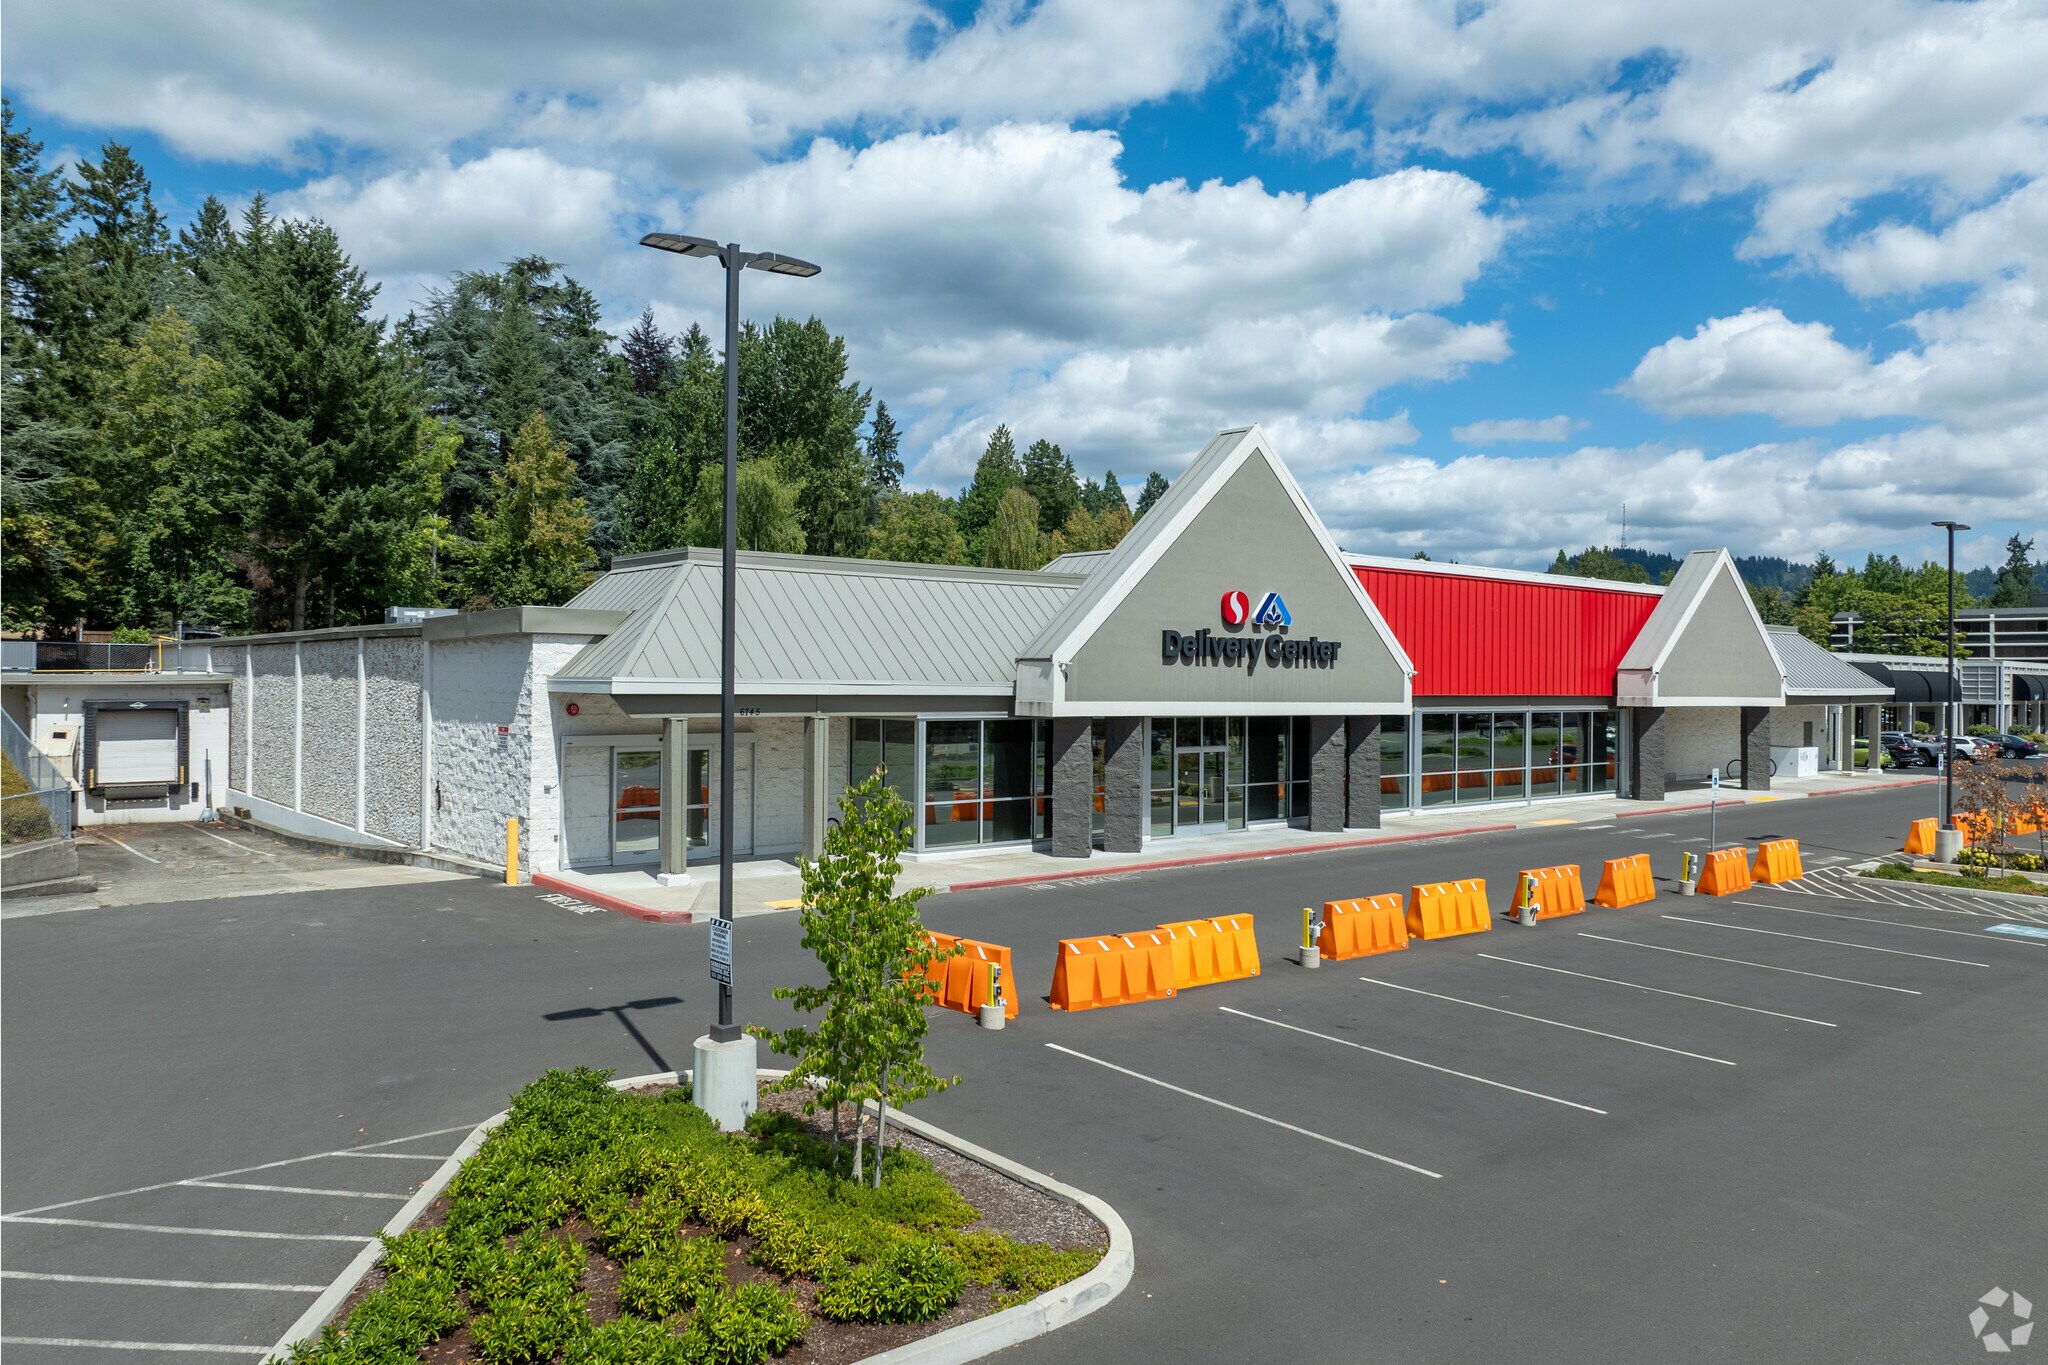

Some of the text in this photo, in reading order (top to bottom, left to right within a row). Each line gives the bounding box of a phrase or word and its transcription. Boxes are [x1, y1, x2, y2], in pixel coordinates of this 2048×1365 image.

[1162, 628, 1341, 670] Delivery Center
[740, 707, 760, 716] 6745
